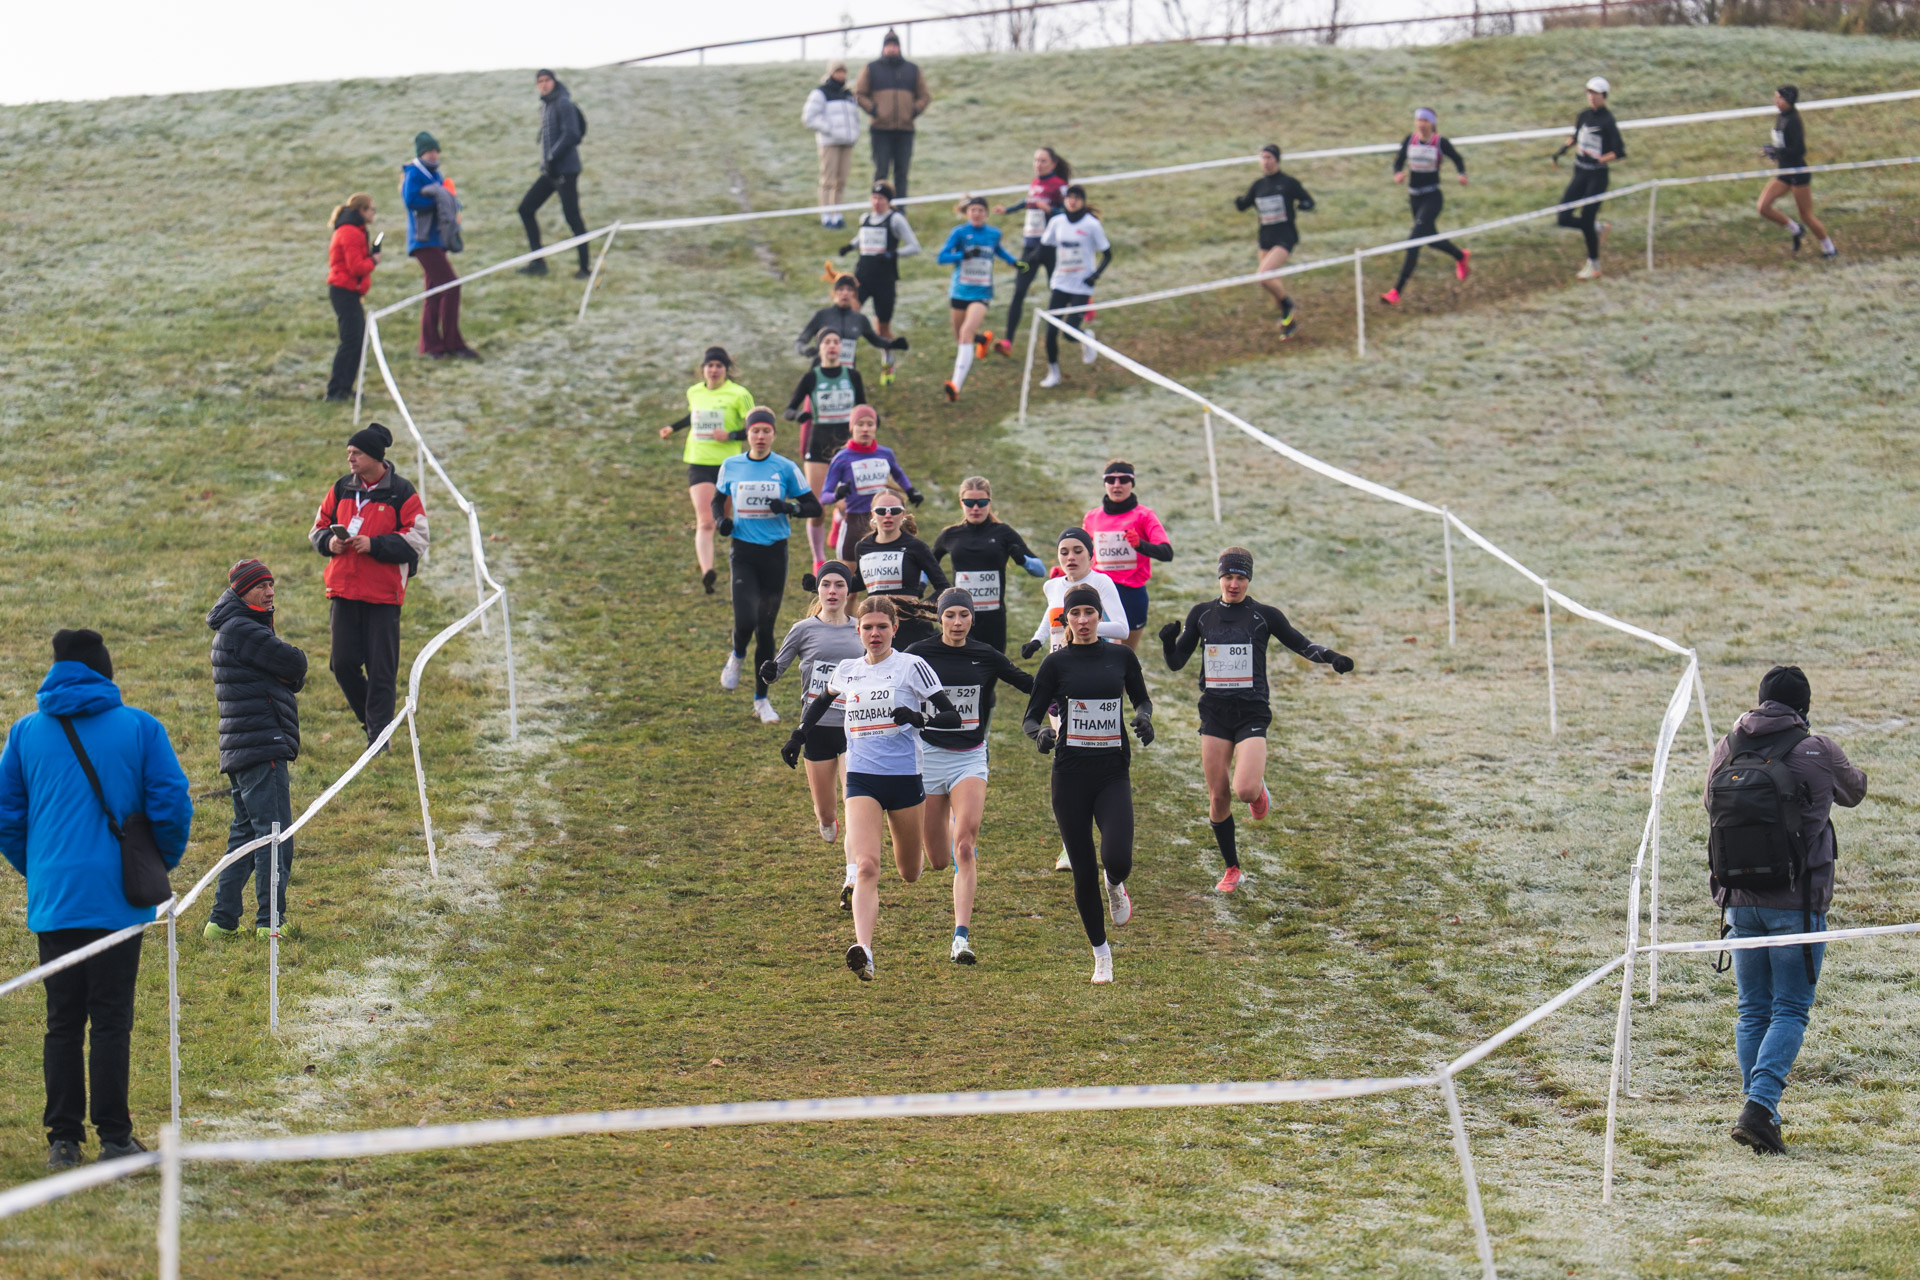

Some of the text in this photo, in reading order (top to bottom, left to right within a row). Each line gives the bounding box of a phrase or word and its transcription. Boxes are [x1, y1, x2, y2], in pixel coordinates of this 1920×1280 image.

[1099, 547, 1130, 556] GUSKA
[980, 574, 996, 582] 500
[1229, 646, 1248, 655] 801
[816, 664, 836, 674] 4F
[812, 679, 828, 690] PIAT
[871, 690, 889, 700] 220
[957, 688, 976, 697] 529
[1099, 702, 1117, 712] 489
[848, 707, 893, 722] STRZĄBAŁA
[1072, 719, 1116, 730] THAMM
